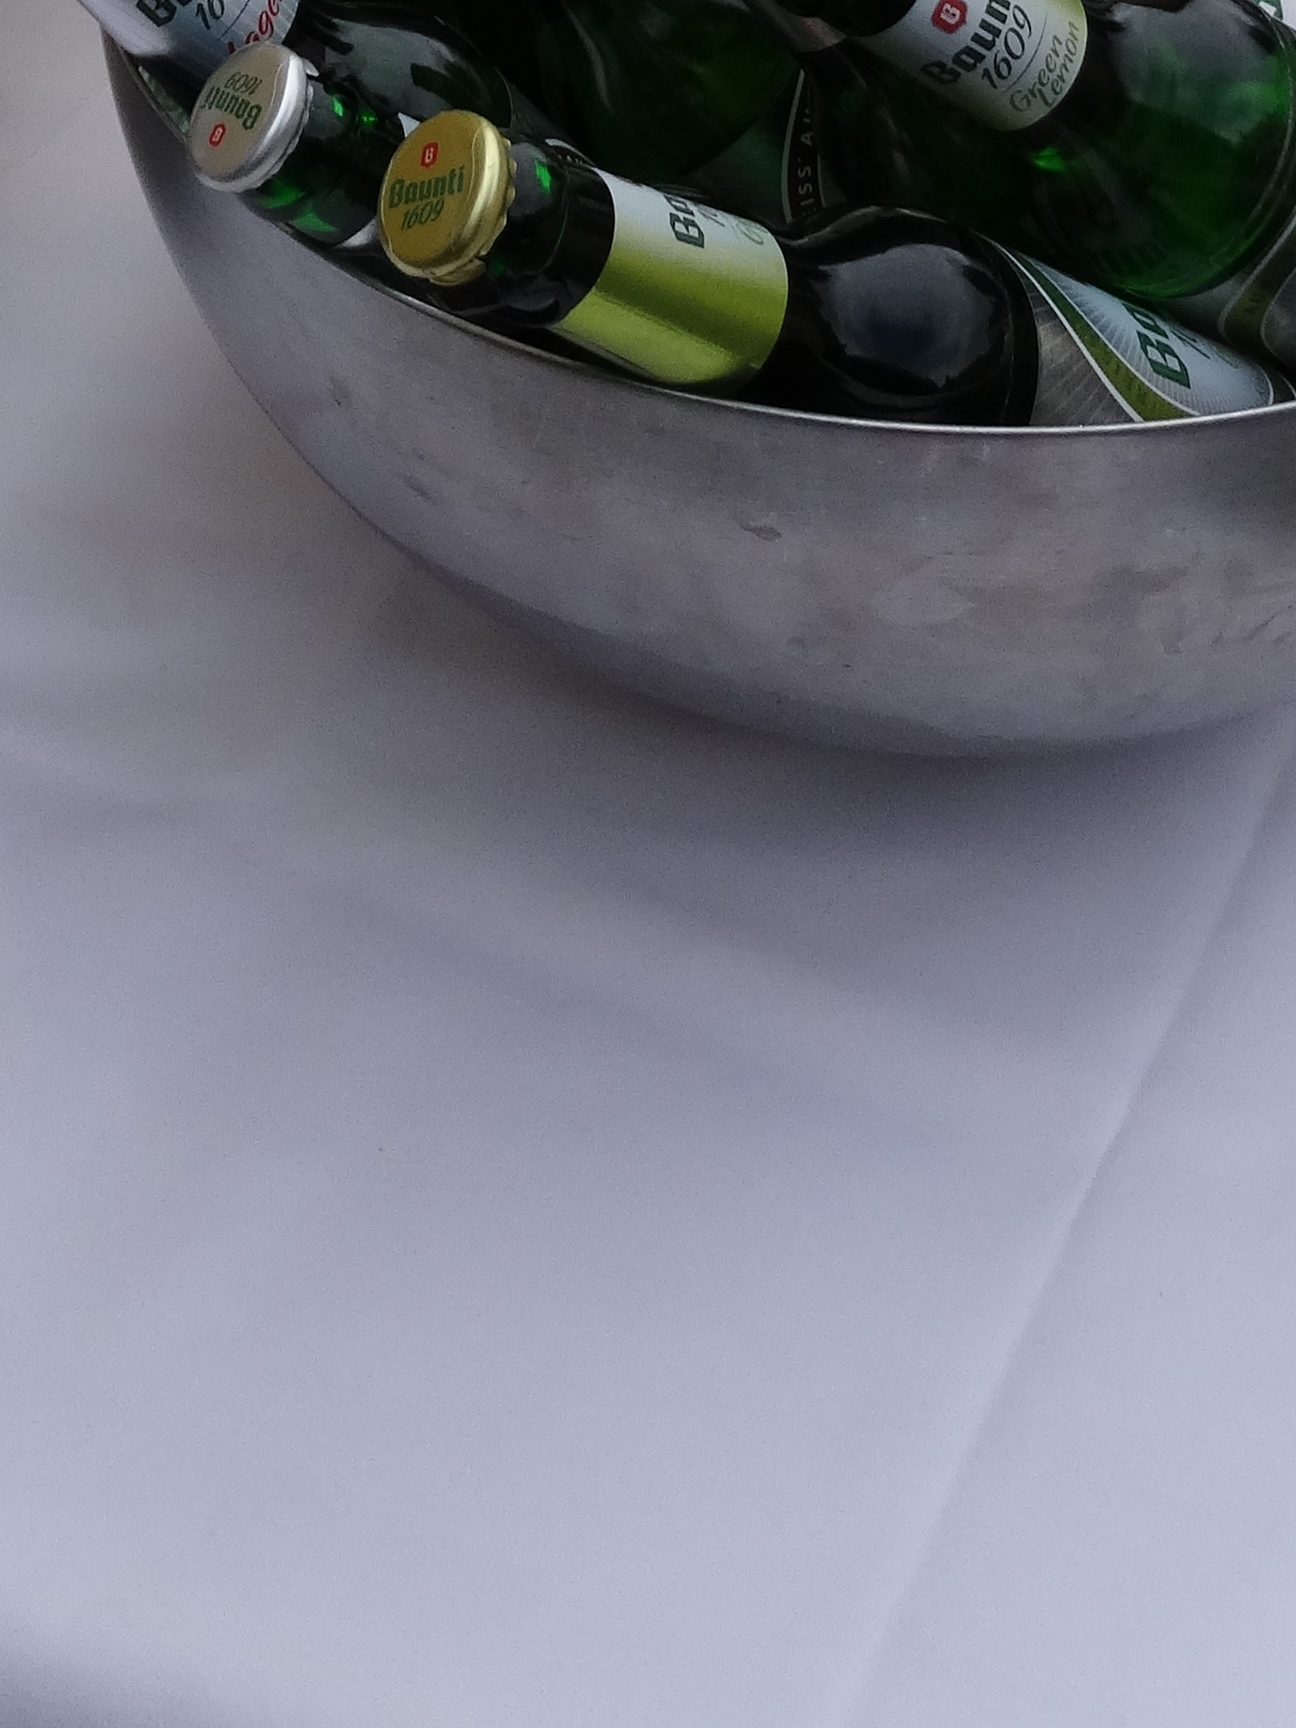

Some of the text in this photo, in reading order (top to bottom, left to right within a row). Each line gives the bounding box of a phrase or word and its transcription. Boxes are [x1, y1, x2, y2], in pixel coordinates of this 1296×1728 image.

[981, 5, 1032, 90] 1609
[1036, 21, 1081, 108] Lemon
[226, 71, 262, 91] 1609
[1009, 34, 1063, 113] Green
[201, 87, 262, 131] Baunti
[388, 165, 465, 210] Baunti
[401, 201, 445, 231] 1609
